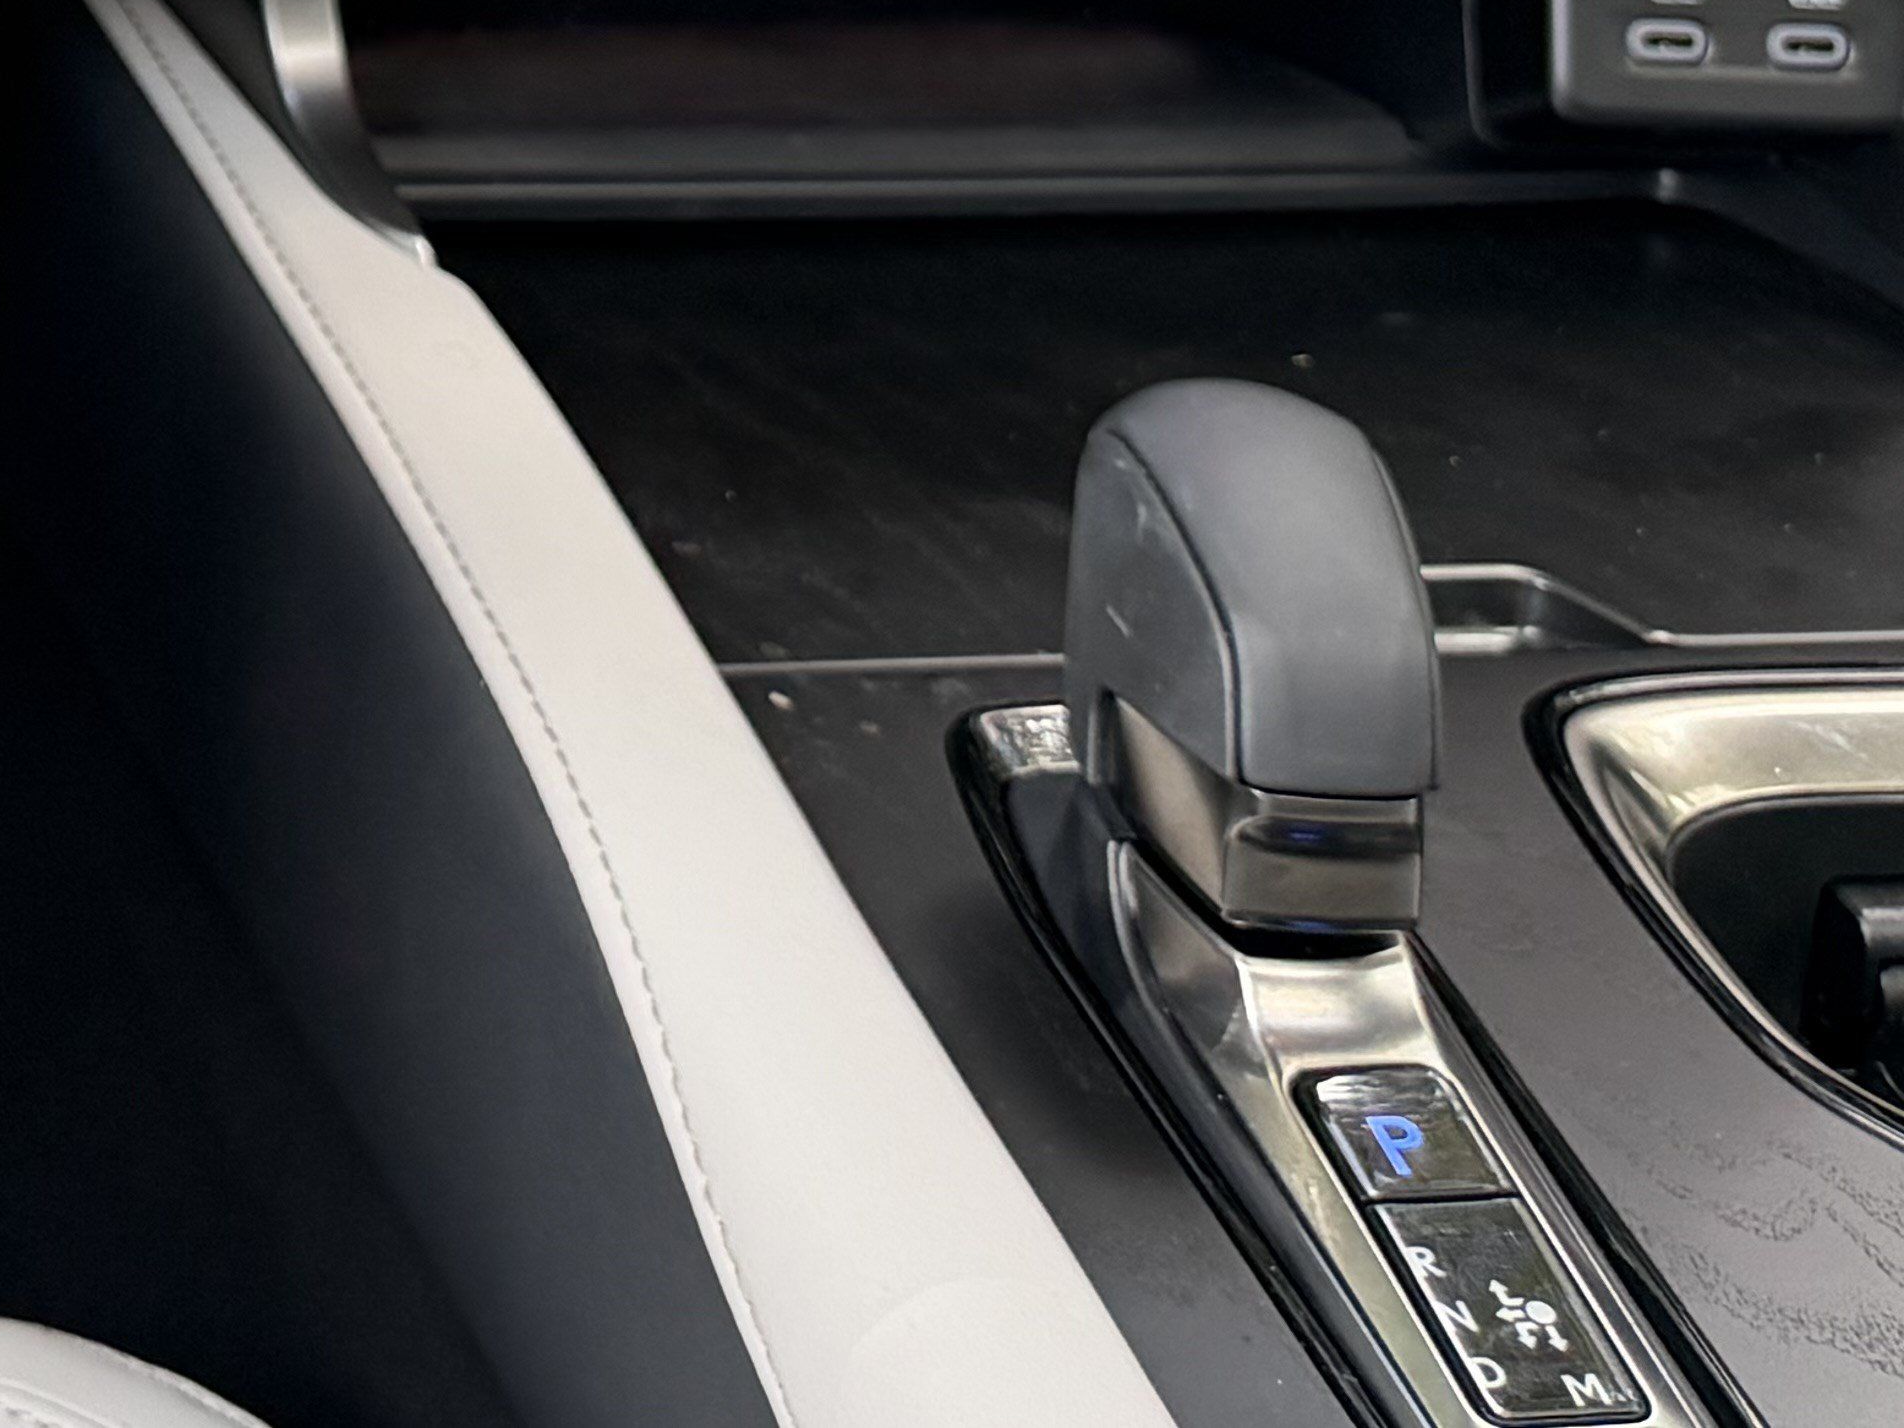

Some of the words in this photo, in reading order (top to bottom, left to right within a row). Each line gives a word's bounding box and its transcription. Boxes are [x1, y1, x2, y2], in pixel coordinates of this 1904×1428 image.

[1366, 1115, 1424, 1177] P
[1404, 1246, 1447, 1278] R
[1434, 1301, 1480, 1333] N
[1468, 1357, 1506, 1388] D
[1560, 1373, 1611, 1406] M
